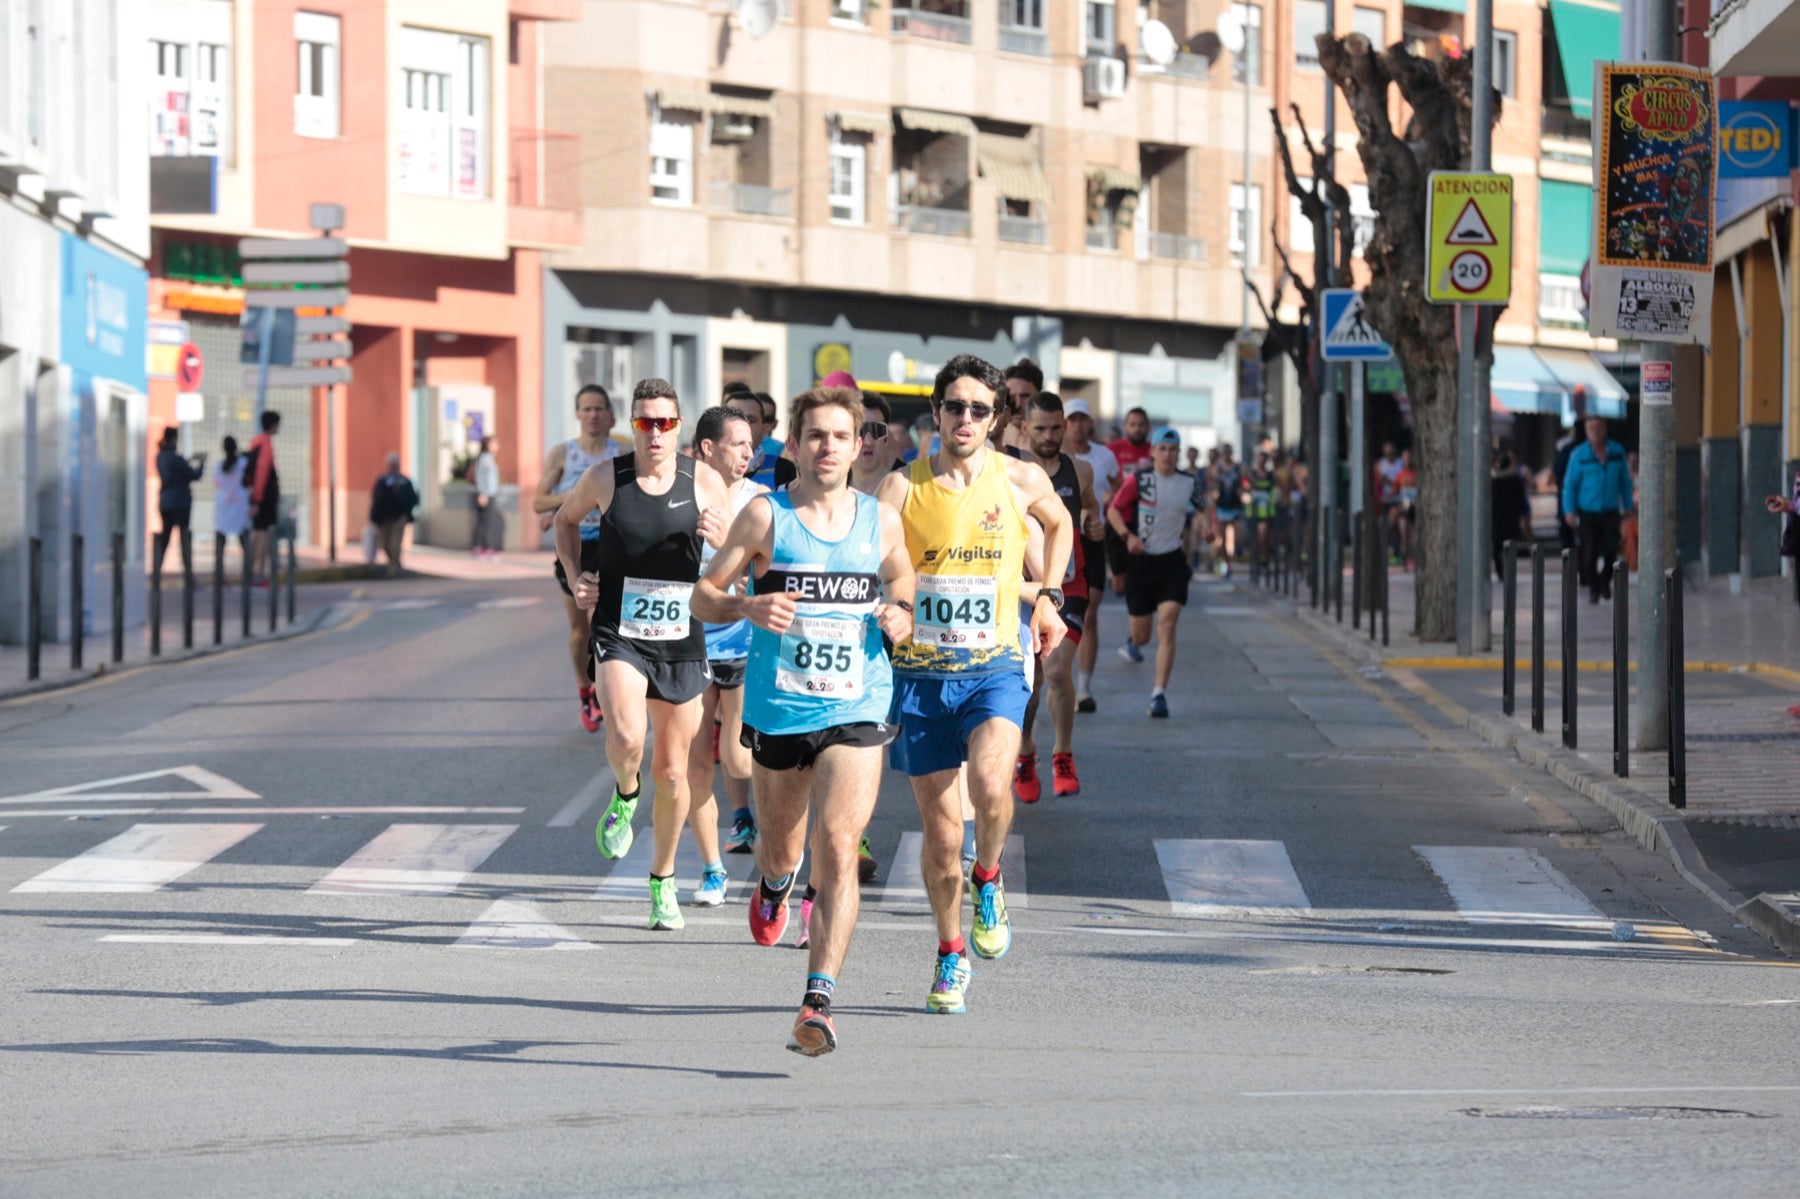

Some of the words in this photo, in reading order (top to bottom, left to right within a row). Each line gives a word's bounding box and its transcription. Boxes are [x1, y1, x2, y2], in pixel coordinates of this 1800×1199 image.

[1643, 91, 1691, 112] CIRCUS
[1647, 111, 1687, 127] APOLO
[1613, 166, 1621, 177] Y
[1623, 153, 1672, 174] MUCHOS
[1436, 180, 1509, 195] ATENCION
[1458, 263, 1482, 278] 20
[1621, 296, 1638, 313] 13
[1680, 300, 1694, 318] 16
[948, 546, 1002, 563] Vigilsa
[633, 598, 681, 621] 256
[920, 597, 991, 624] 1043
[795, 641, 852, 672] 855
